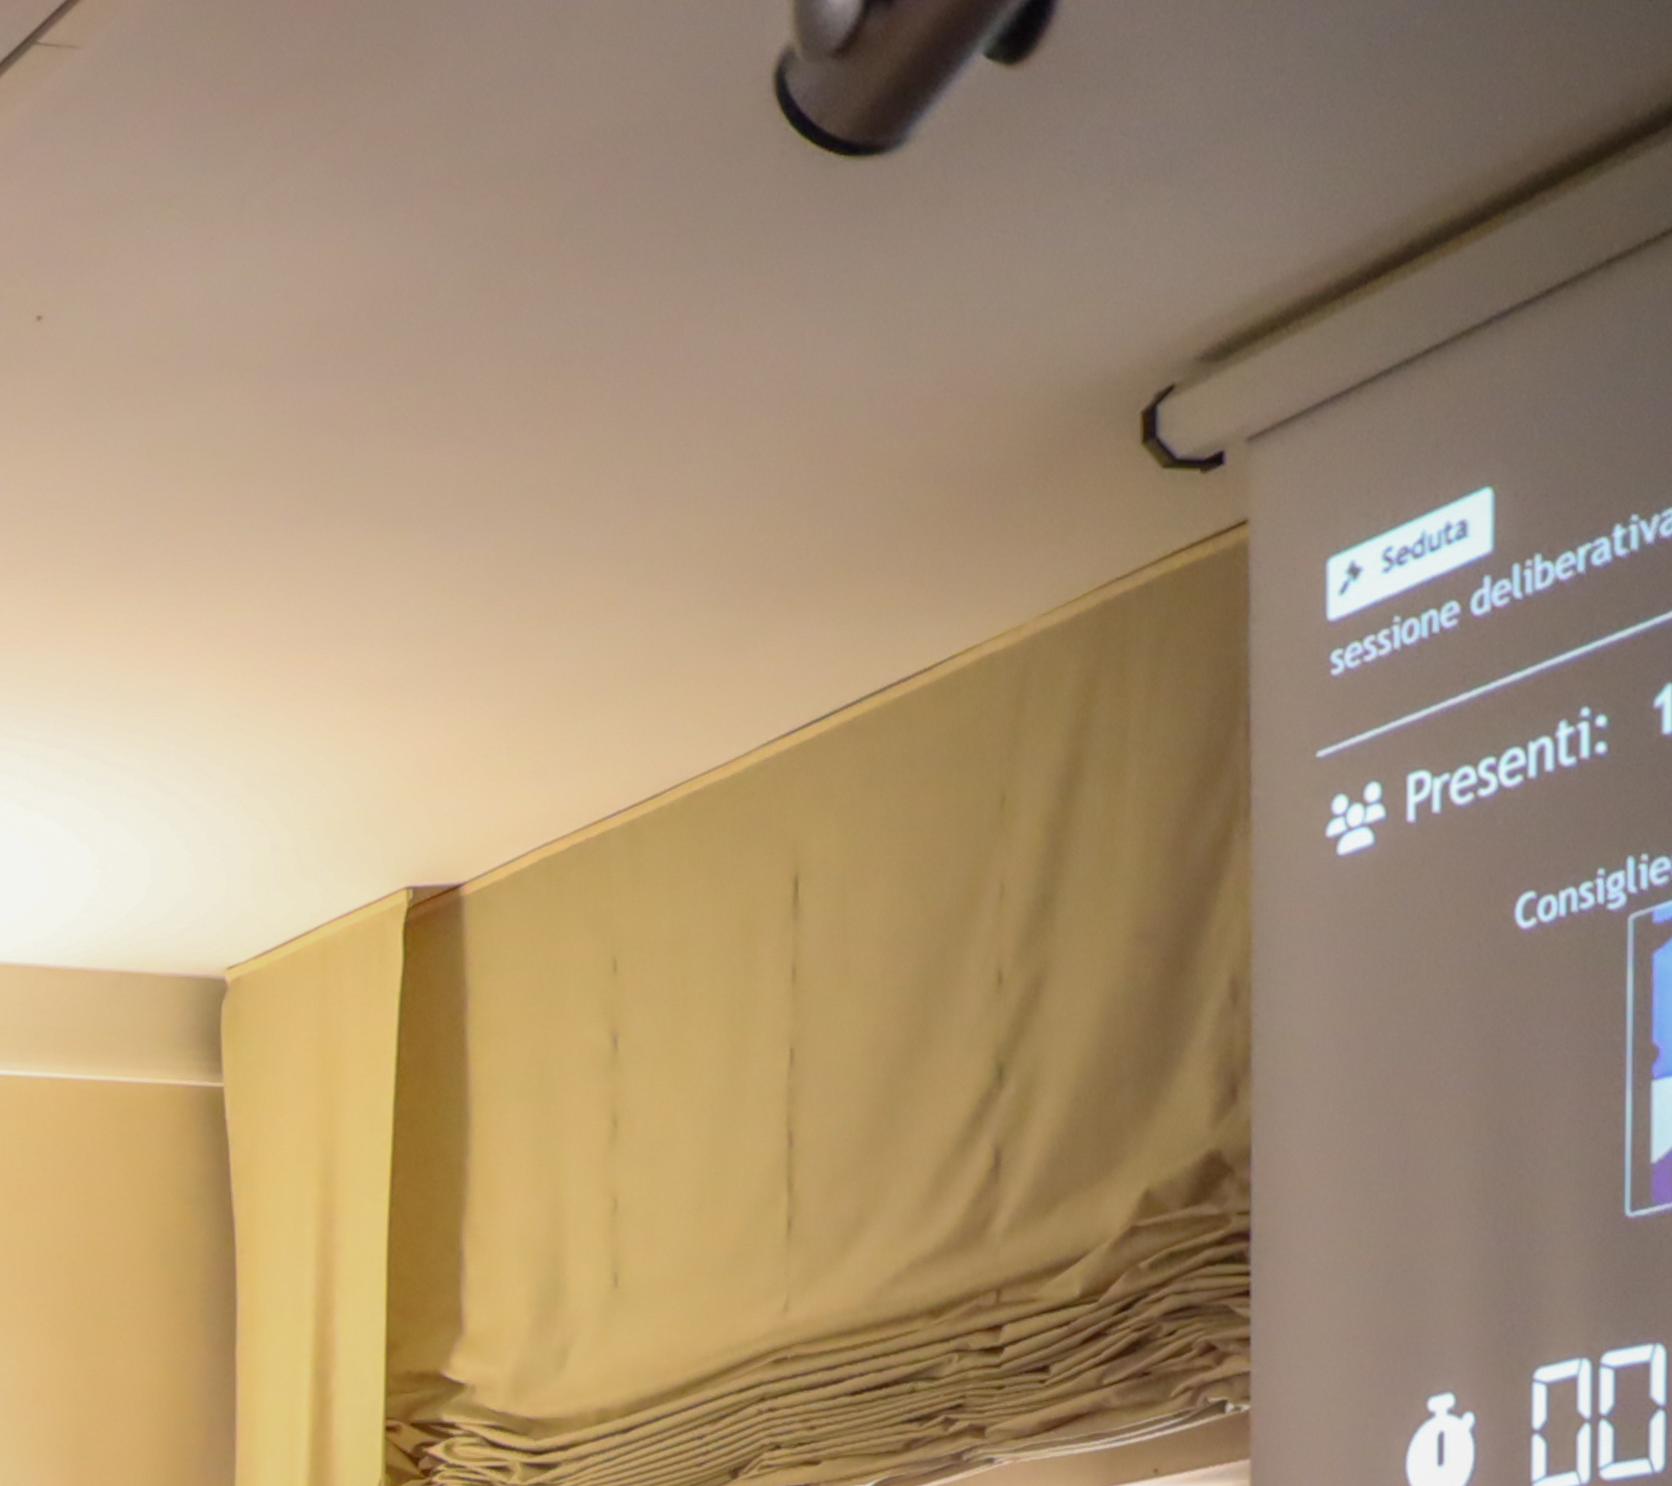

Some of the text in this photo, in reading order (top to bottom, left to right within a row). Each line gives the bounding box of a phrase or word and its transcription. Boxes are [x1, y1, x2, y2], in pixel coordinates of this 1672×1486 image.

[1330, 506, 1672, 677] sessione deliberativa
[1381, 518, 1469, 574] Seduta
[1406, 706, 1608, 823] Presenti:
[1515, 853, 1672, 929] Consiglie
